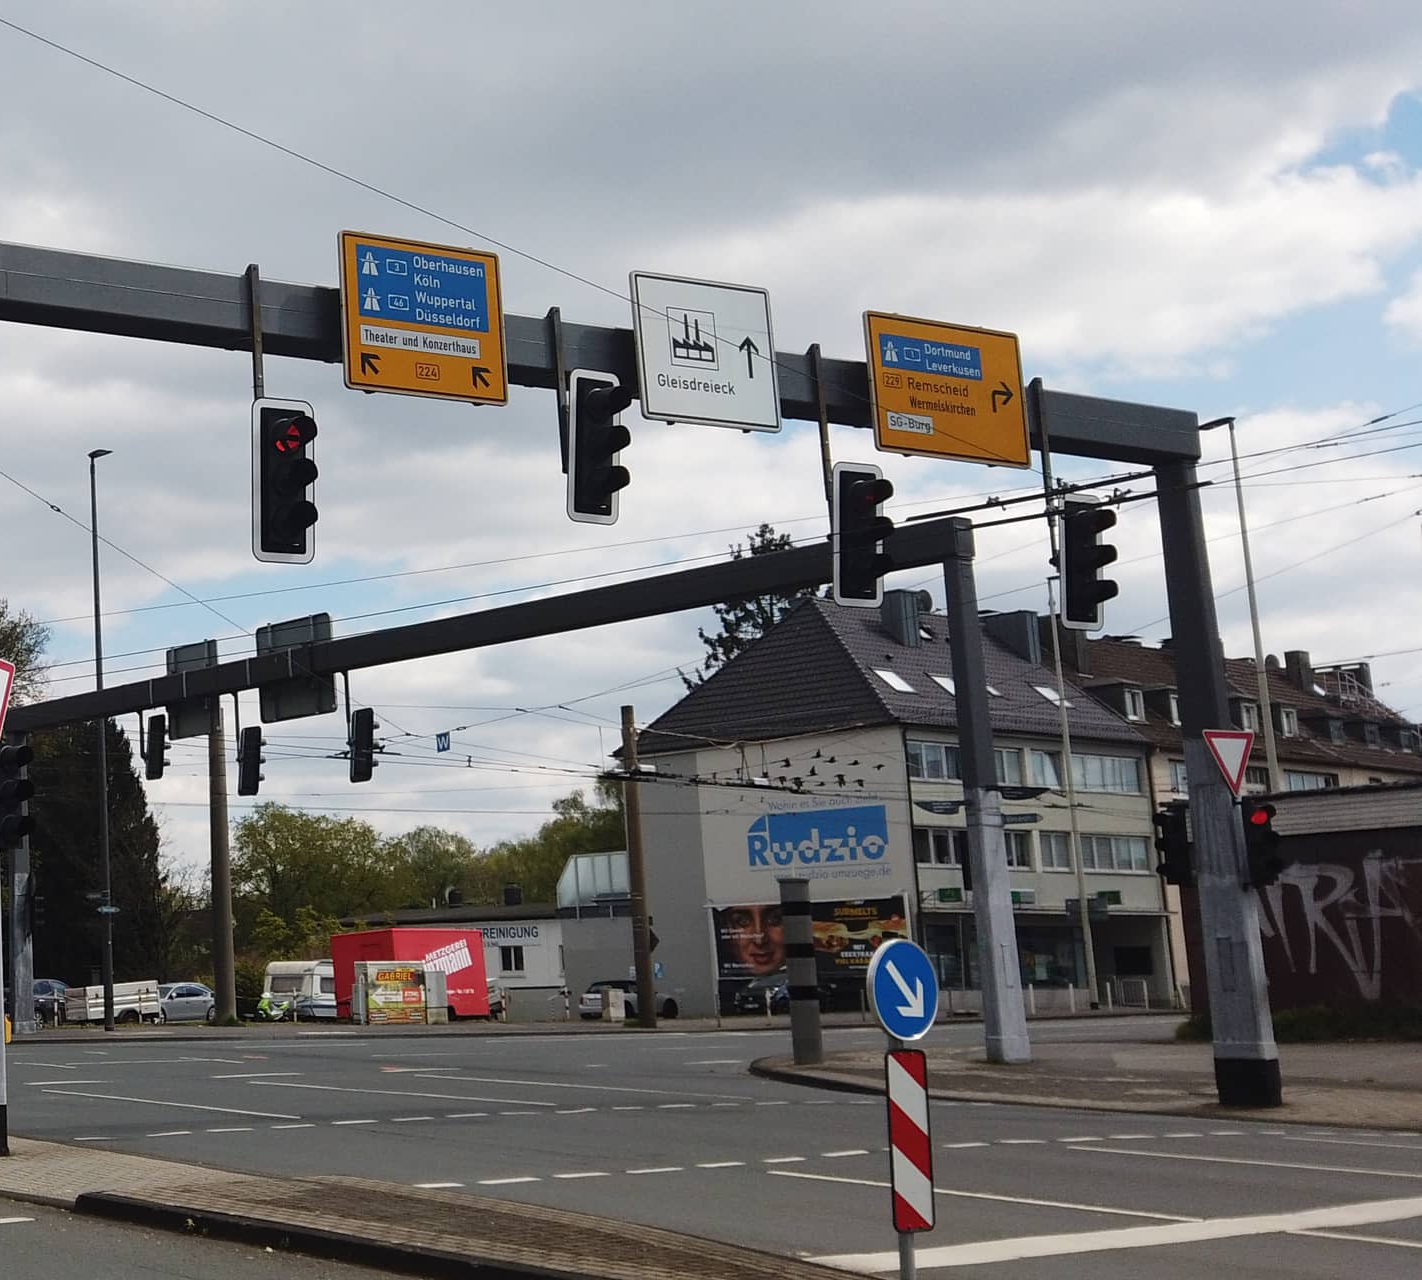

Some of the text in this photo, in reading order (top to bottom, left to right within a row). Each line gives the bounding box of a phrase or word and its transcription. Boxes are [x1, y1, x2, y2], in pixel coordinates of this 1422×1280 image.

[394, 263, 400, 271] 3
[413, 256, 484, 278] Oberhausen
[413, 273, 441, 289] Köln
[393, 298, 404, 307] 46
[415, 290, 477, 311] Wuppertal
[416, 309, 481, 328] Düsseldorf
[364, 329, 477, 354] Theater und Konzerthaus
[924, 343, 971, 361] Dortmund
[418, 366, 438, 378] 224
[925, 360, 981, 377] Leverkusen
[657, 373, 736, 396] Gleisdreieck
[885, 374, 900, 387] 229
[907, 377, 969, 398] Remscheid
[909, 395, 976, 416] Wermelskirchen
[889, 415, 931, 434] SG-Burg
[437, 735, 449, 750] W
[747, 826, 885, 867] Rudzio
[480, 926, 539, 940] REINIGUNG
[377, 971, 412, 980] GABRIEL
